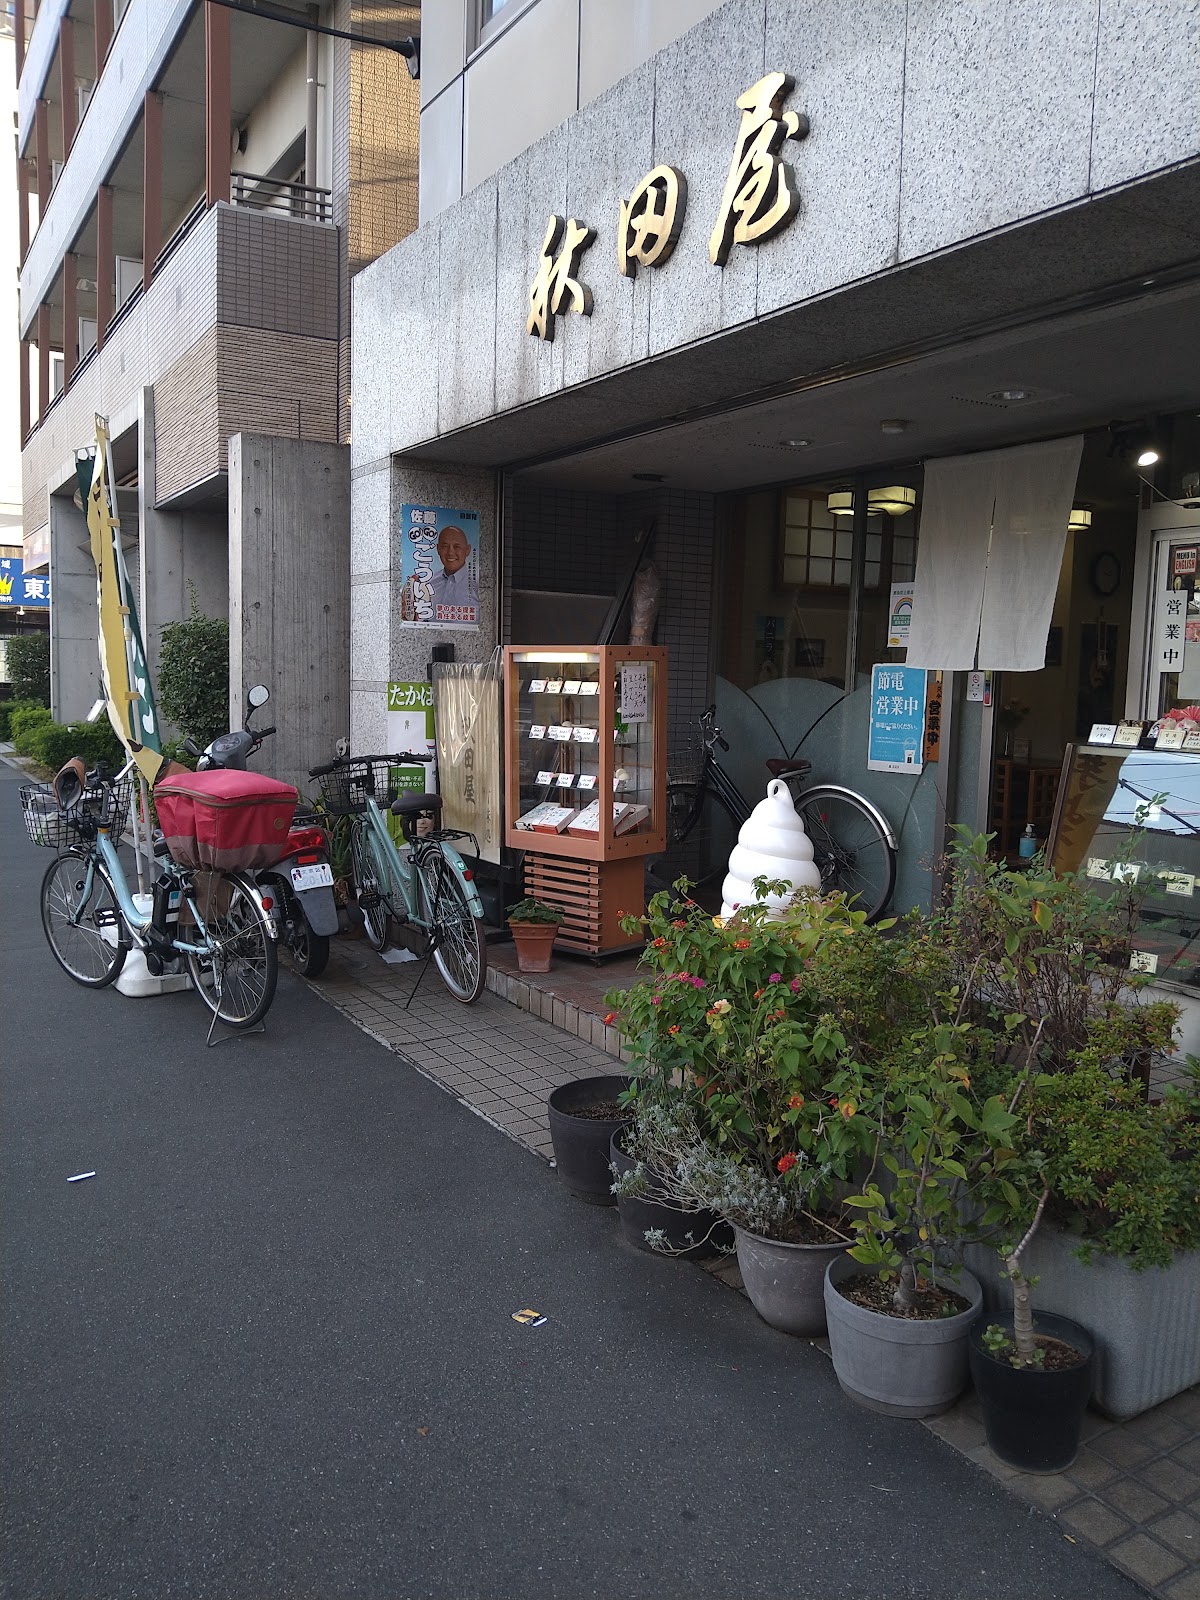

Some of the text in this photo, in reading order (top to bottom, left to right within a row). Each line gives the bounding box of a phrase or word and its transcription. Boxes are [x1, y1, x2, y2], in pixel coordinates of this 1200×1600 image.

[410, 509, 436, 525] 佐藤
[1176, 552, 1190, 560] MENU
[1176, 560, 1196, 570] ENGLISH
[413, 543, 437, 620] ごういち
[437, 605, 475, 613] 夢のある提案
[1164, 599, 1182, 664] 営業中
[877, 672, 904, 691] 節電
[876, 696, 918, 716] 営業中
